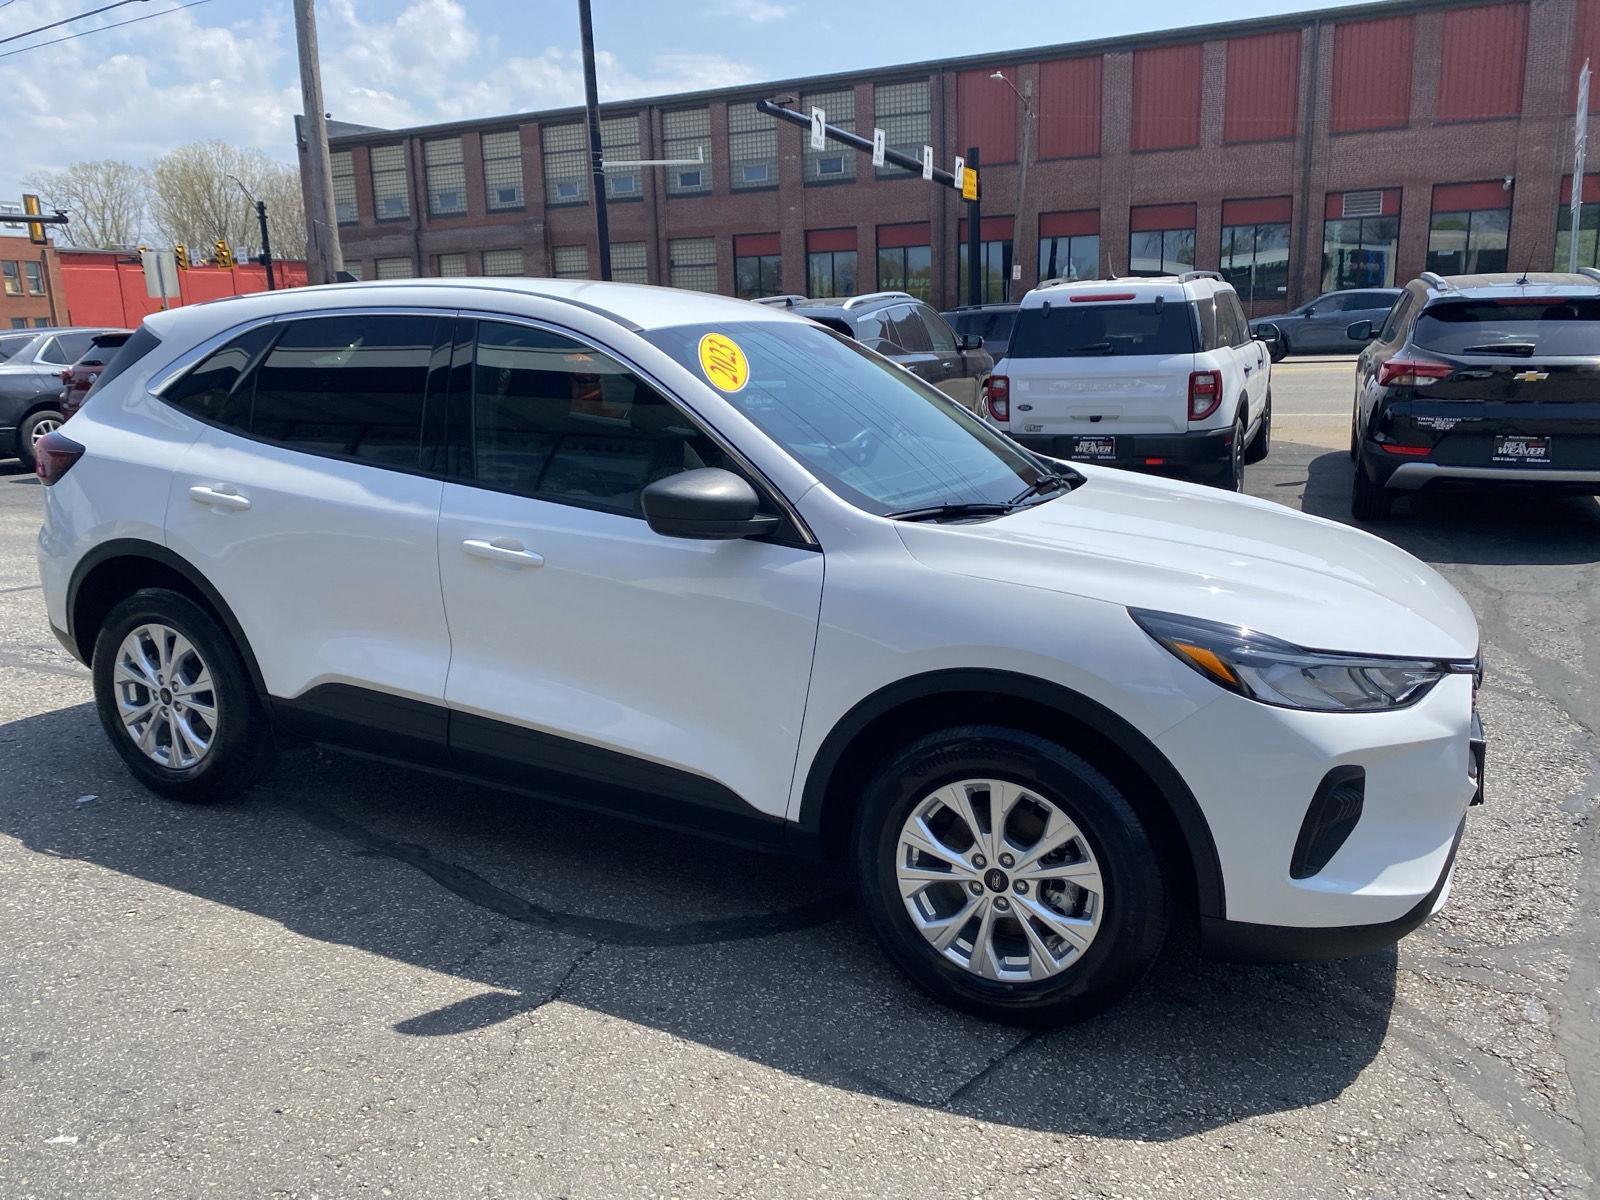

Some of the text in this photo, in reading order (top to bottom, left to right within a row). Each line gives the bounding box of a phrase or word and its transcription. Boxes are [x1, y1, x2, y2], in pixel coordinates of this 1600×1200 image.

[708, 338, 738, 385] 2023
[1503, 441, 1527, 449] RICK
[1075, 446, 1112, 454] WEAVER
[1498, 447, 1546, 455] WEAVER
